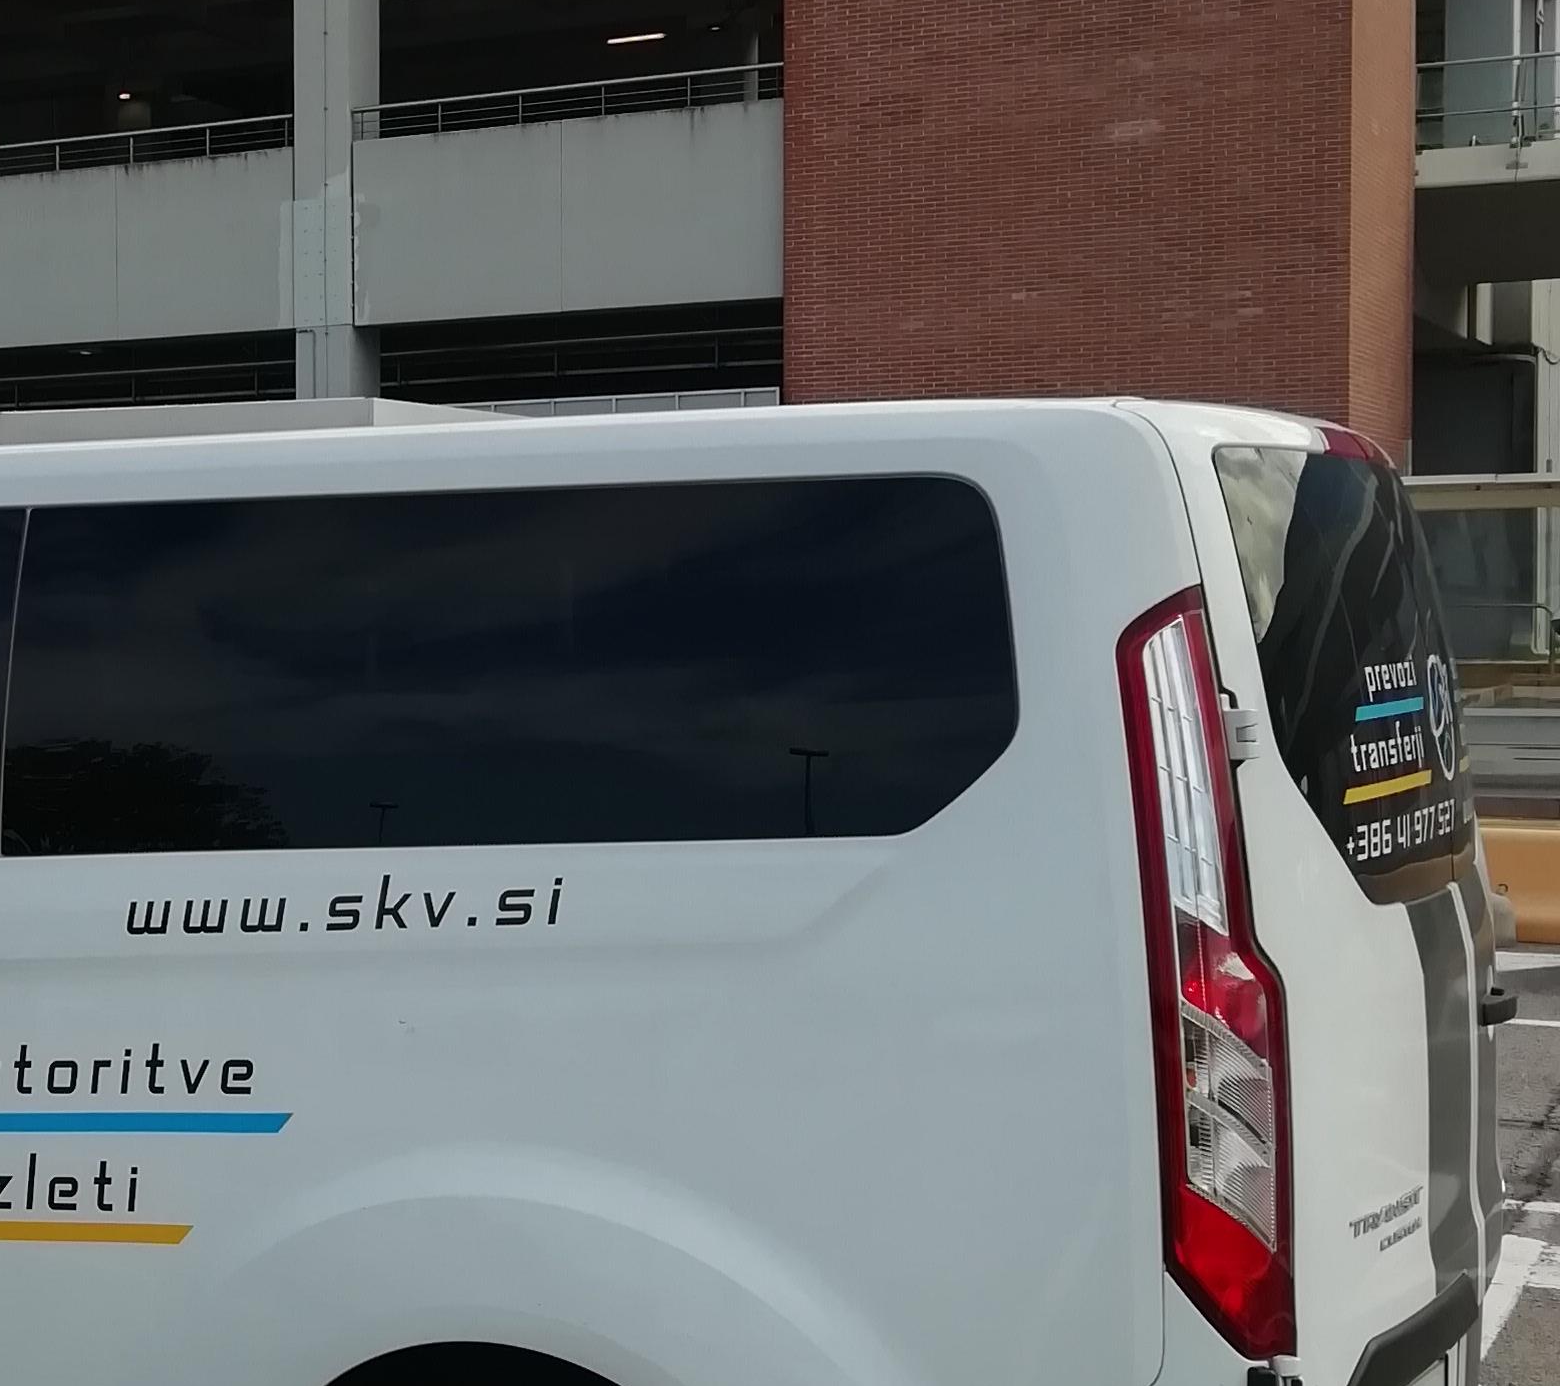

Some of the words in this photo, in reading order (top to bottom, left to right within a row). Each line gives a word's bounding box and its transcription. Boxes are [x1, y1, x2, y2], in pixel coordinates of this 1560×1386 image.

[1364, 655, 1417, 702] prevozi
[1350, 720, 1425, 773] transferji
[1346, 819, 1393, 862] +386
[1397, 813, 1411, 849] 41
[1414, 805, 1436, 845] 977
[1438, 798, 1455, 836] 527
[125, 874, 564, 936] www.skv.si
